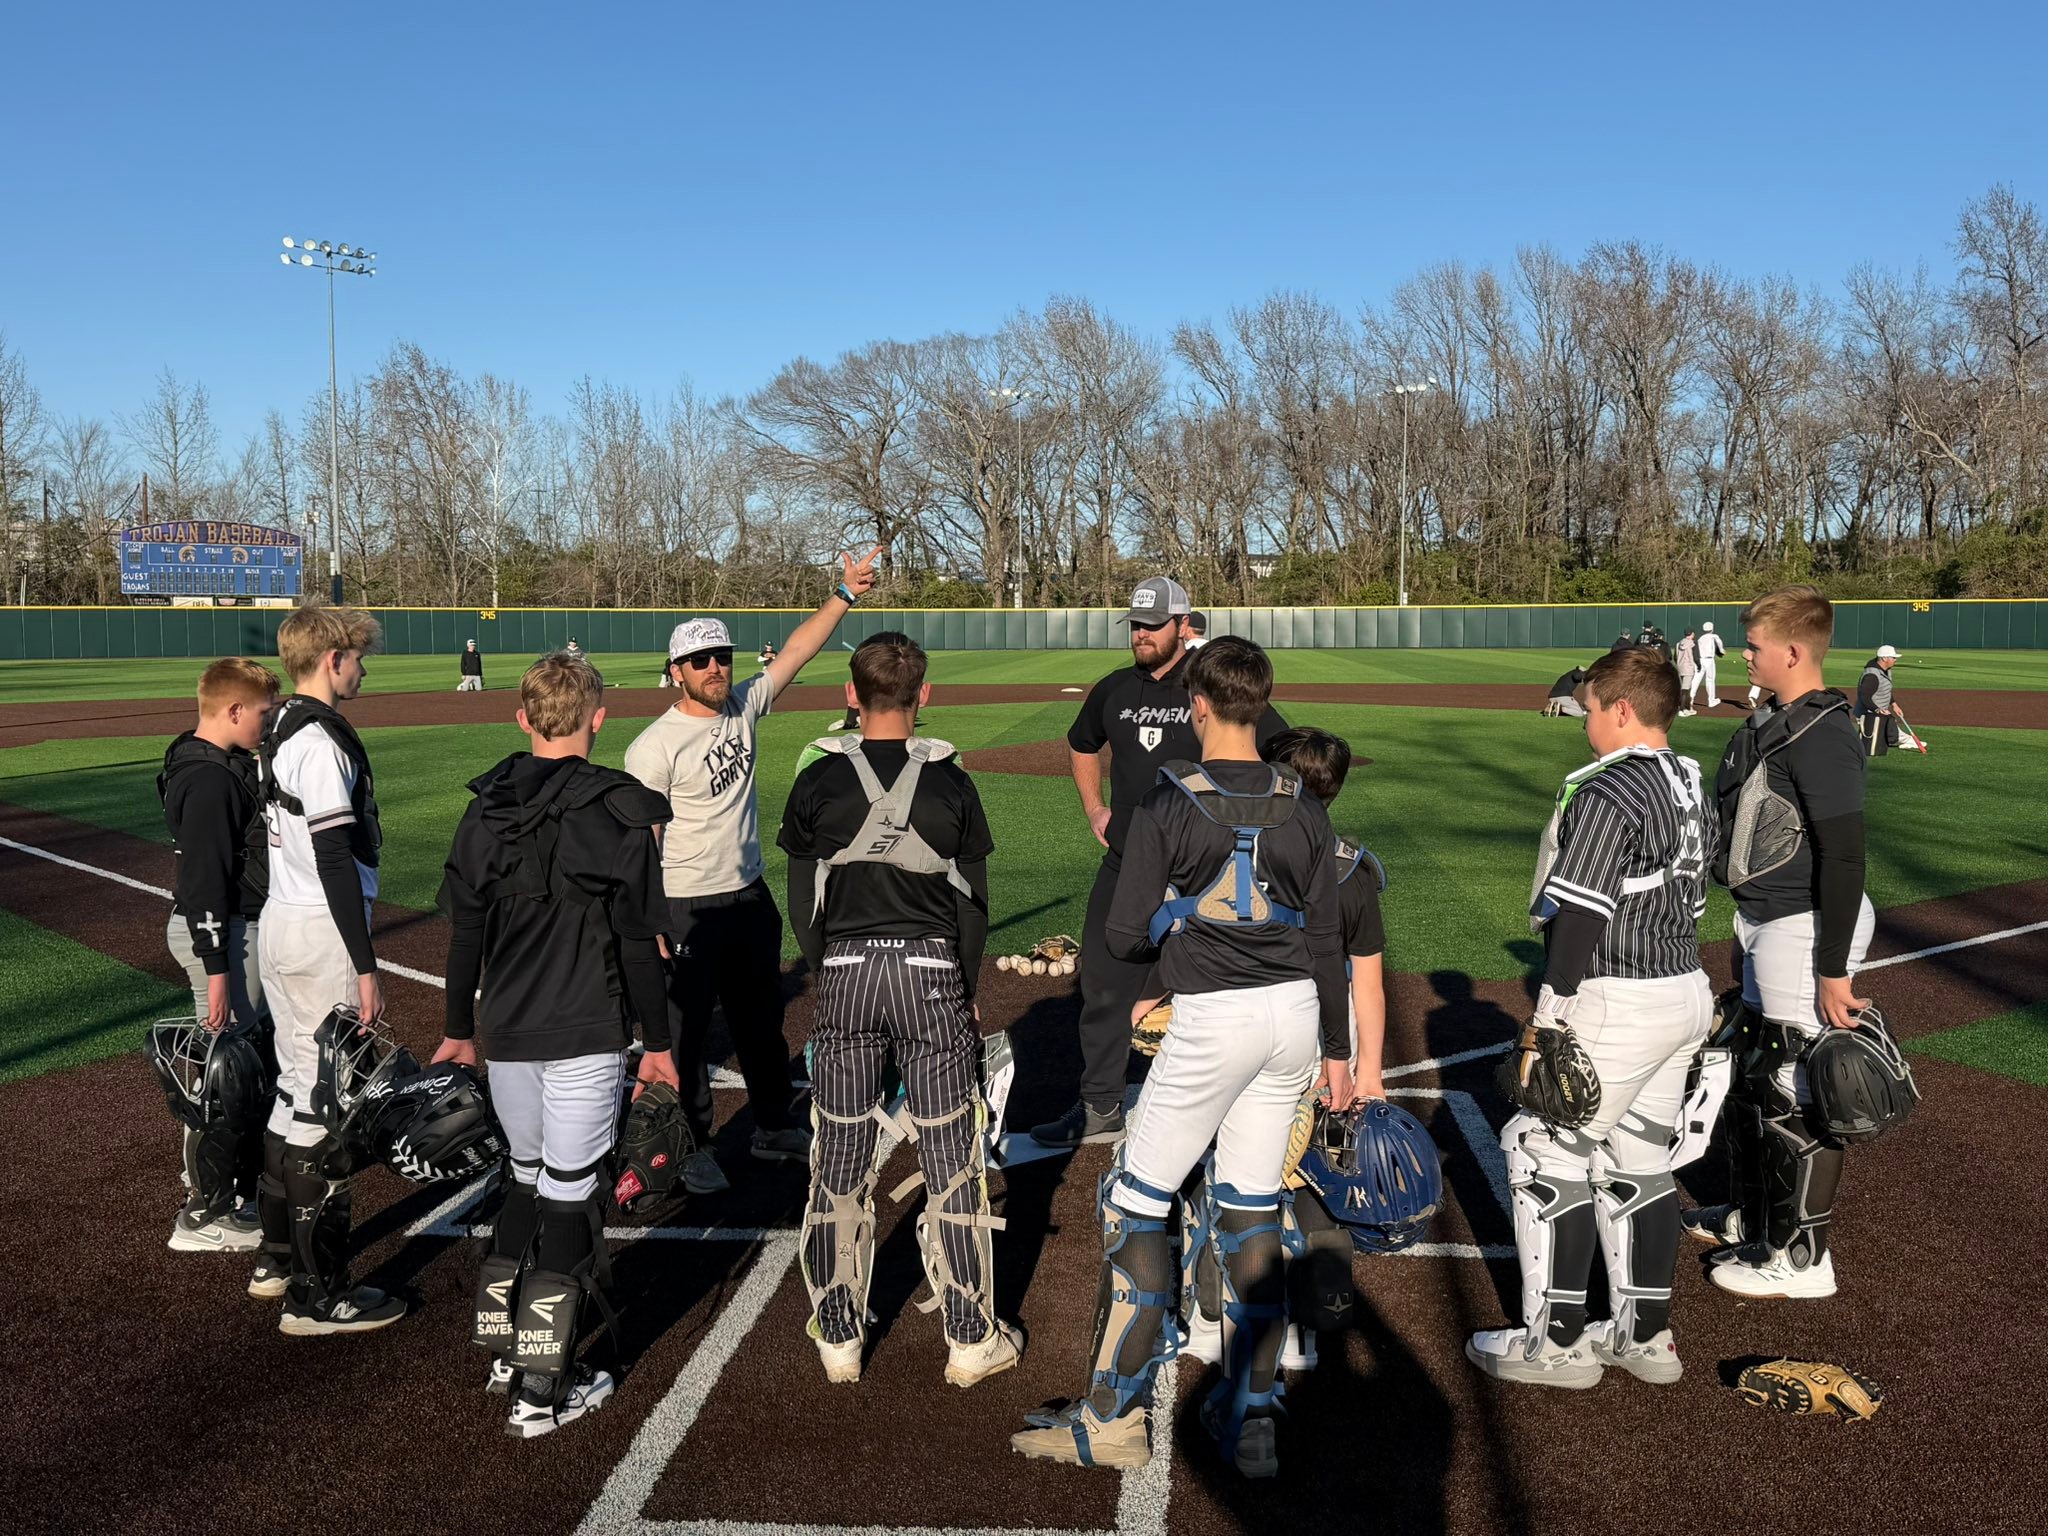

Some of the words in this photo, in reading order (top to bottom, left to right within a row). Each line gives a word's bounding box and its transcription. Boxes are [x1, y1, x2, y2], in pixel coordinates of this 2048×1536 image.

[129, 523, 199, 543] TROJAN
[206, 523, 295, 546] BASEBALL
[123, 572, 149, 580] GUEST
[122, 582, 150, 592] TROJANS
[1912, 602, 1930, 612] 345
[480, 610, 496, 620] 345
[1119, 706, 1192, 725] #GMEN
[1147, 730, 1155, 746] G
[1559, 1073, 1575, 1103] A2000
[477, 1311, 508, 1323] KNEE
[477, 1323, 514, 1335] SAVER
[518, 1330, 554, 1342] KNEE
[517, 1342, 562, 1355] SAVER
